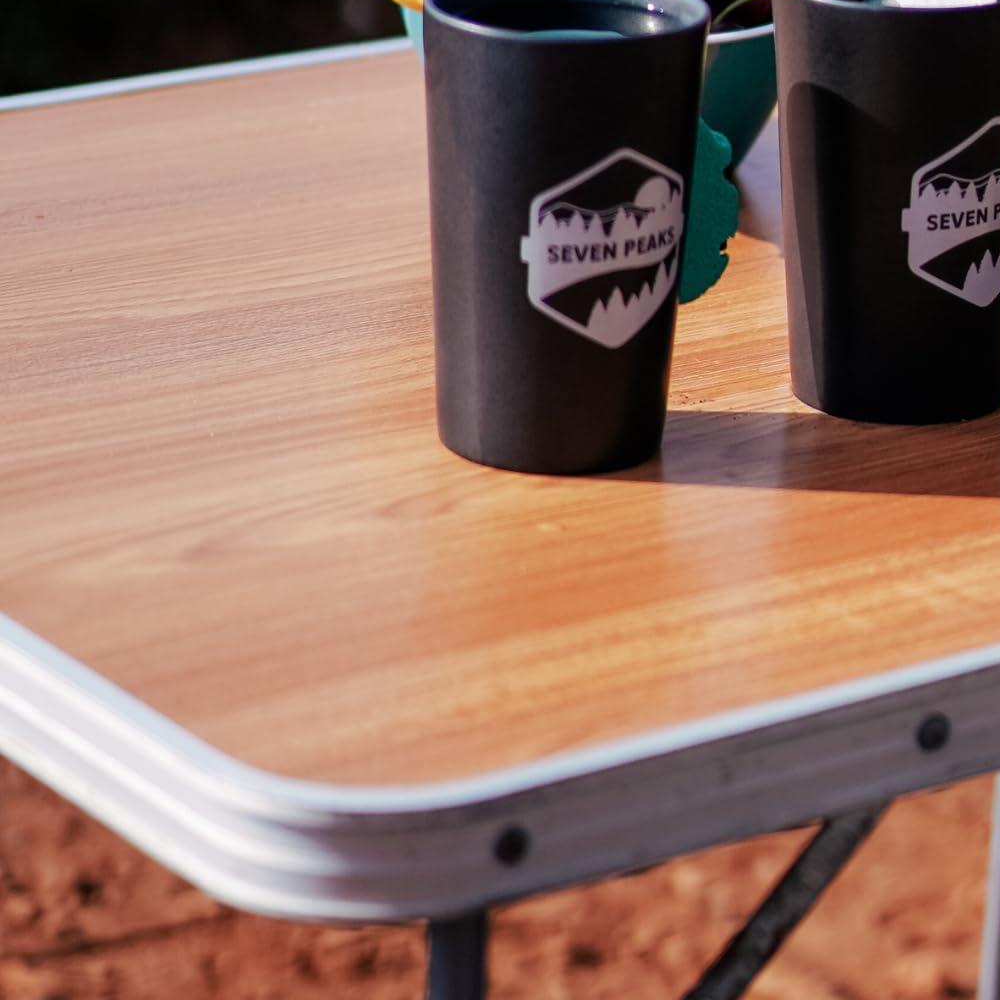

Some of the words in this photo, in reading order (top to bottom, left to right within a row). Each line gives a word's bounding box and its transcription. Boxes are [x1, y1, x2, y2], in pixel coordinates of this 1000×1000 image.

[926, 207, 989, 232] SEVEN
[547, 242, 617, 264] SEVEN
[624, 226, 675, 256] PEAKS
